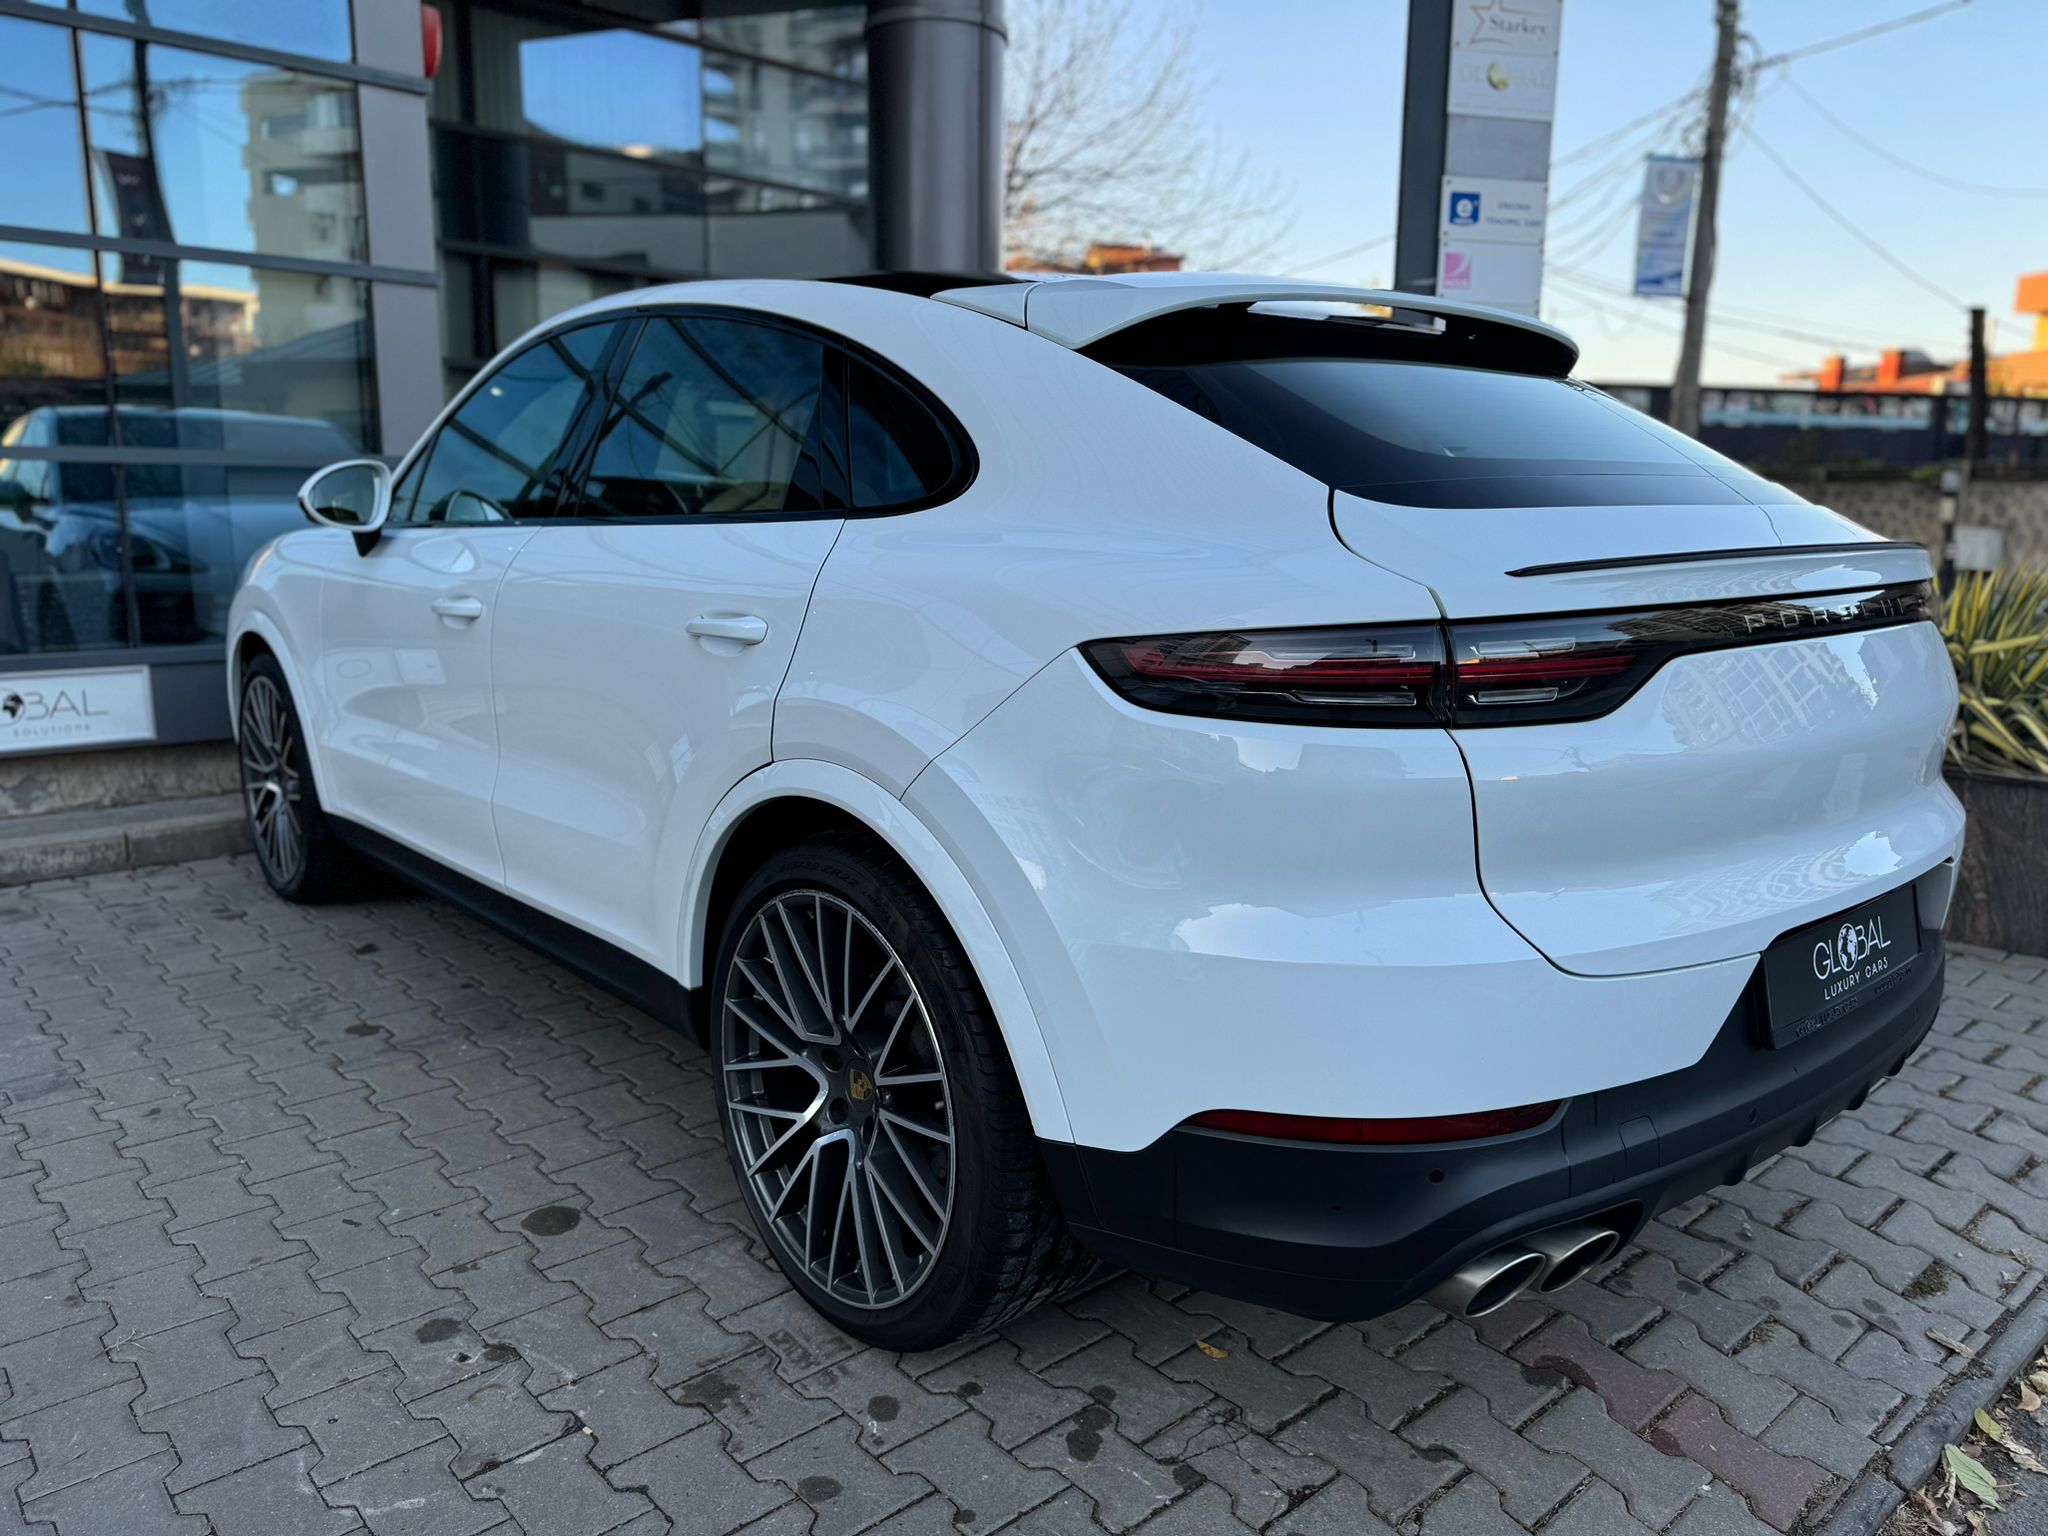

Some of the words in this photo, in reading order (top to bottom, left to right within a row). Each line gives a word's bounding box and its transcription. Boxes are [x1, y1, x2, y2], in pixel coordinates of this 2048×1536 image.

[1488, 15, 1547, 40] Starkey
[1813, 916, 1892, 980] GLOBAL
[1824, 971, 1860, 1001] LUXURY
[1865, 957, 1889, 978] CARS
